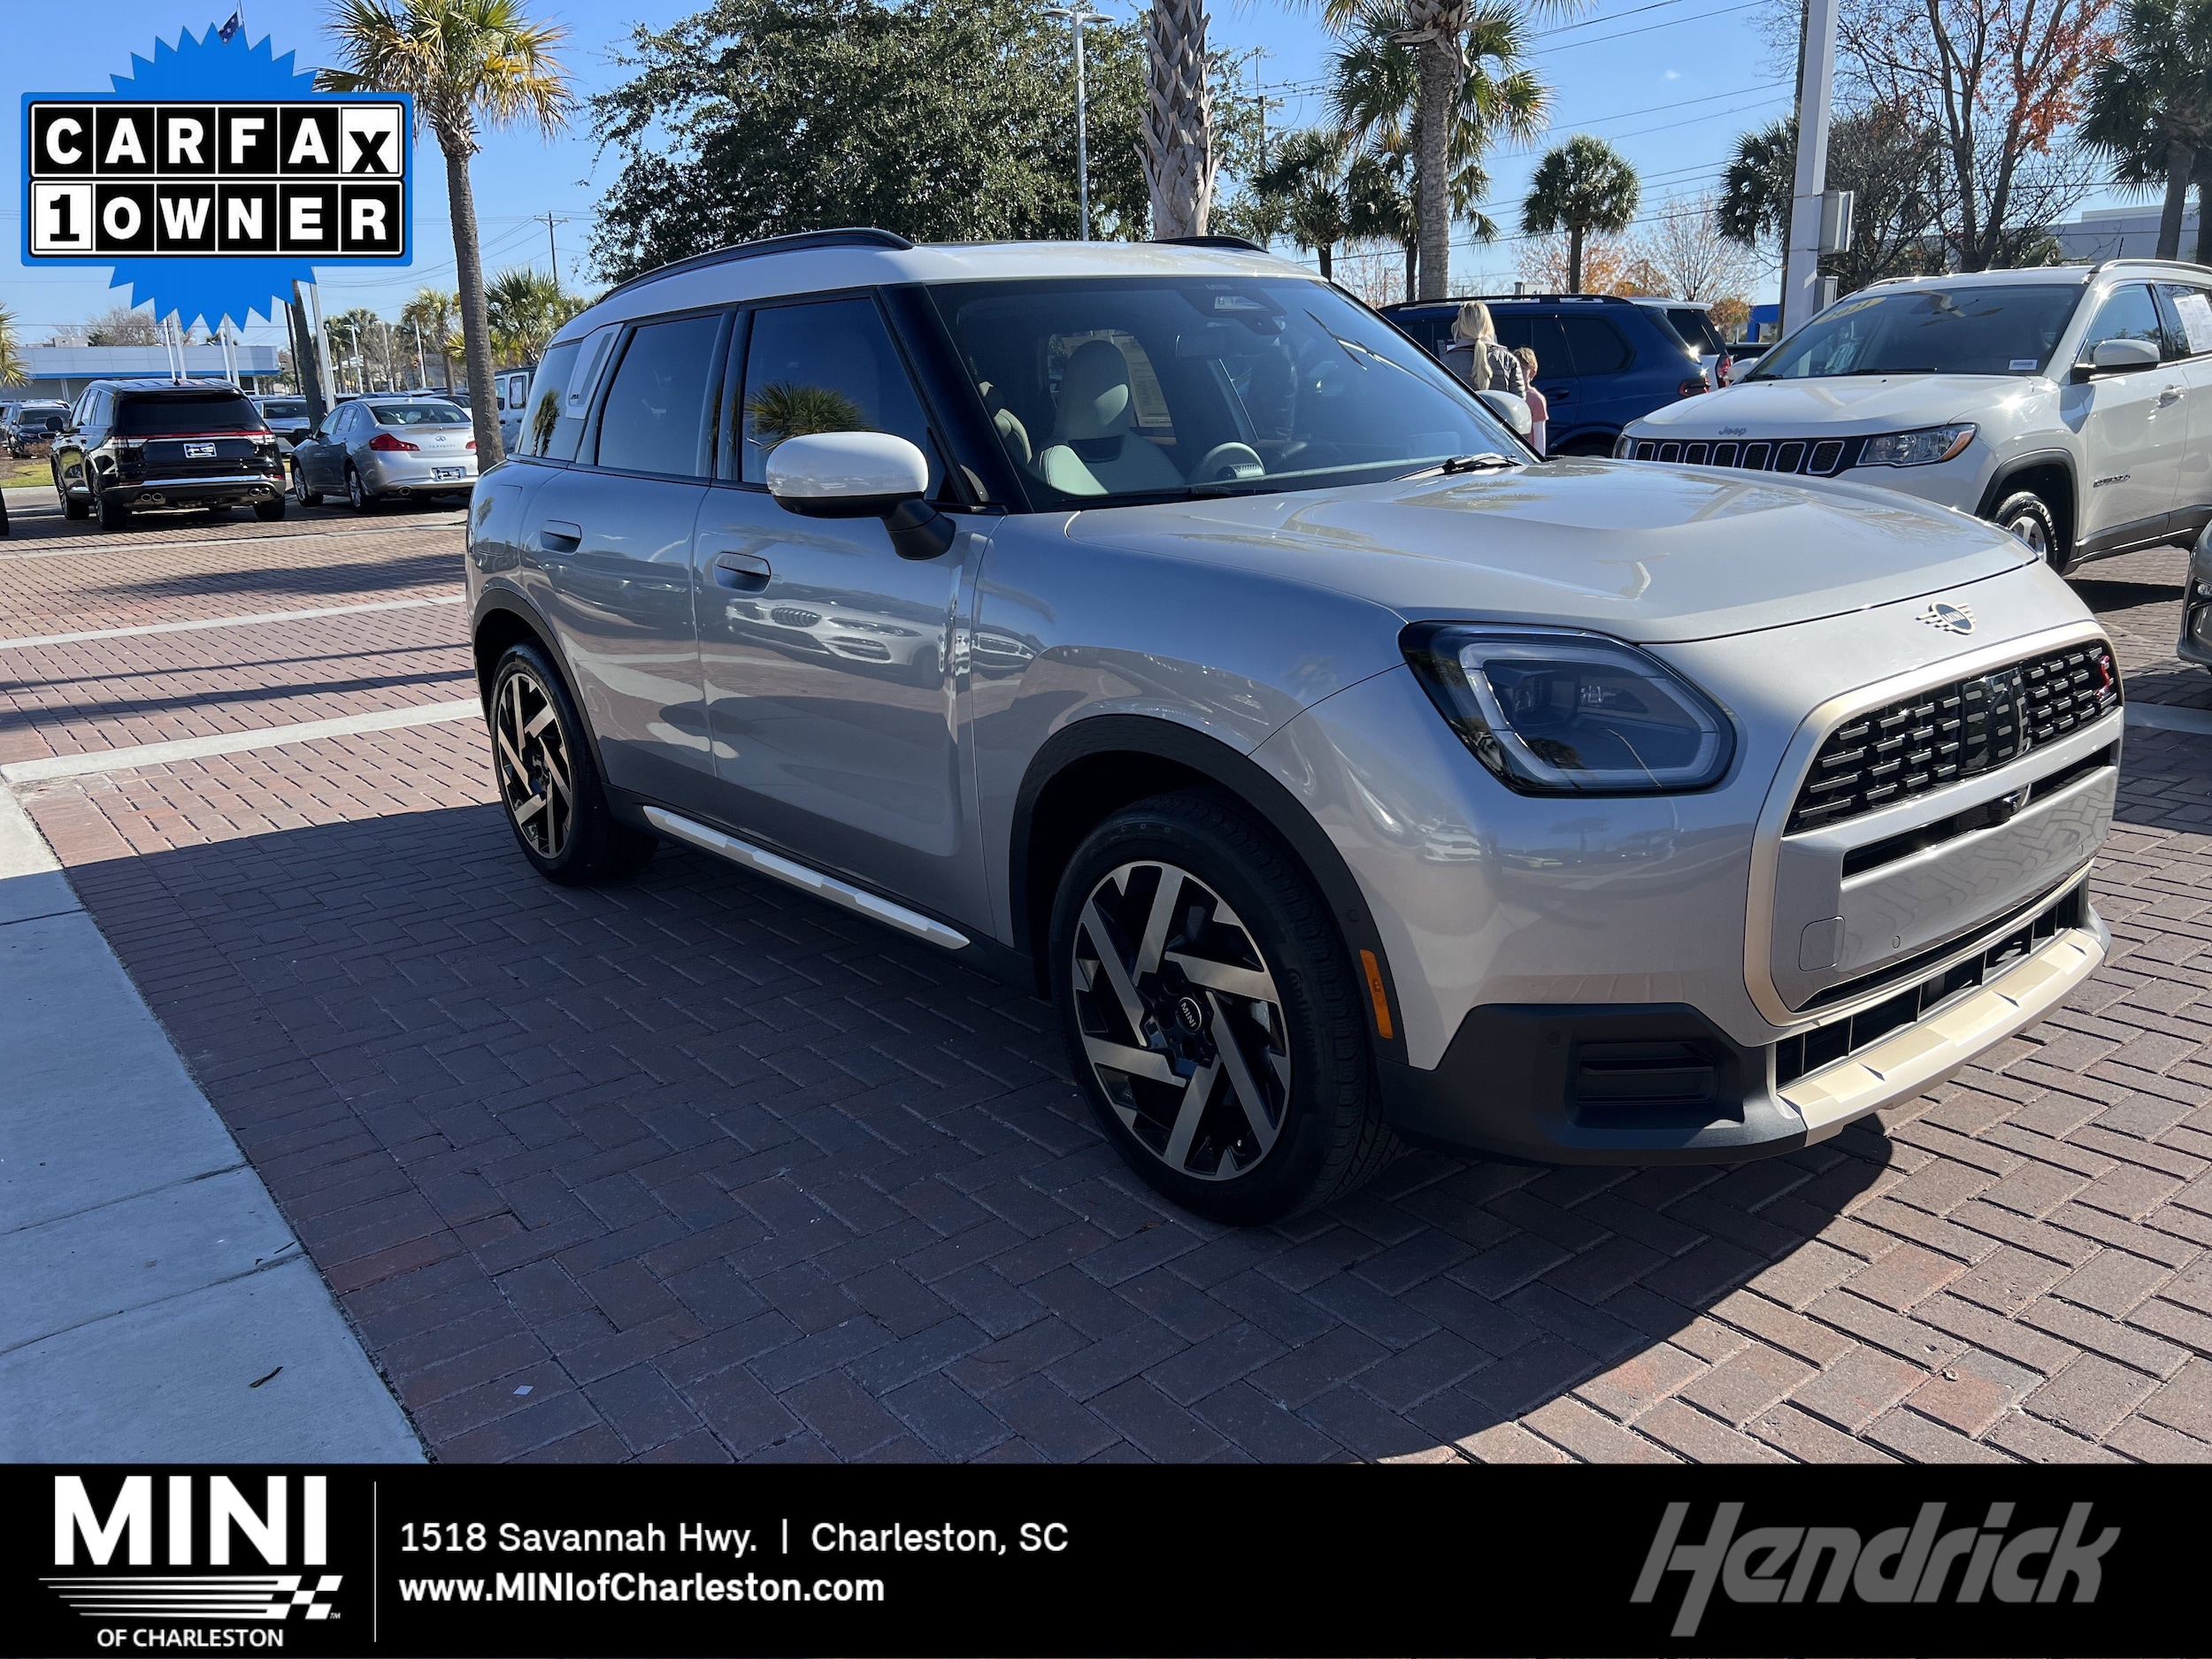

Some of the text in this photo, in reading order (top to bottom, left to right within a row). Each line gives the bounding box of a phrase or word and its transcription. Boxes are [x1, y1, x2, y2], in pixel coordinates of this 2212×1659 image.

[1718, 426, 1747, 437] Jeep
[1940, 610, 1966, 624] MINI
[1180, 1002, 1197, 1027] MINI
